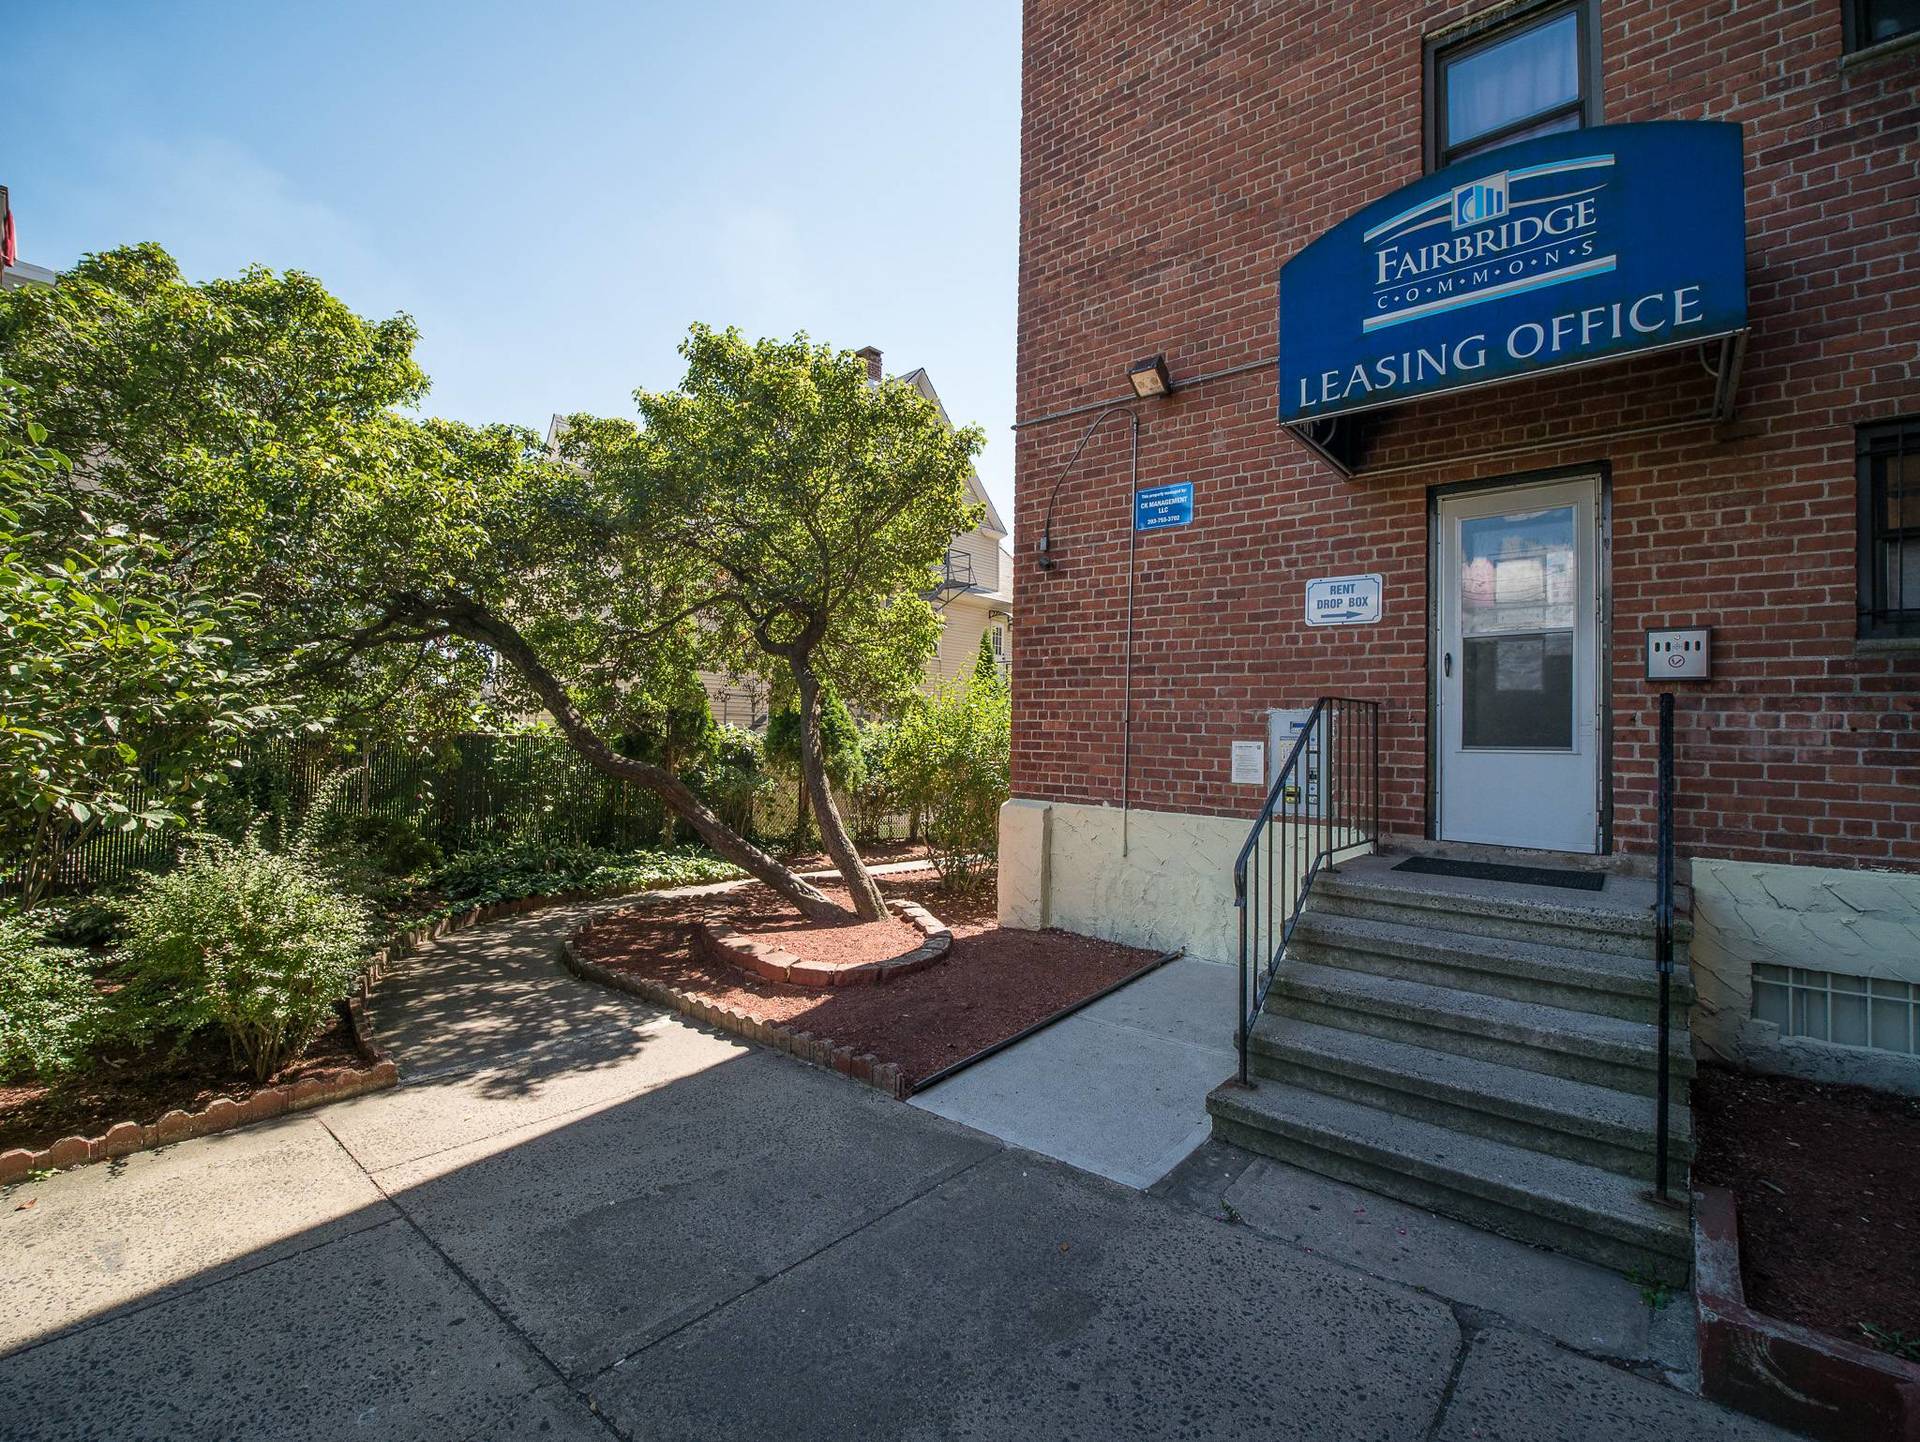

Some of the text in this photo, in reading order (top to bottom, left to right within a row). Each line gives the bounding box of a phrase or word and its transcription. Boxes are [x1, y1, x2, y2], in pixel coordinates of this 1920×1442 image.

[1374, 197, 1597, 285] FAIRBRIDGE
[1299, 285, 1704, 408] LEASING OFFICE
[1149, 496, 1188, 508] MANAGEMENT
[1158, 506, 1169, 514] LLC
[1329, 583, 1356, 596] RENT
[1316, 596, 1369, 610] DROP BOX
